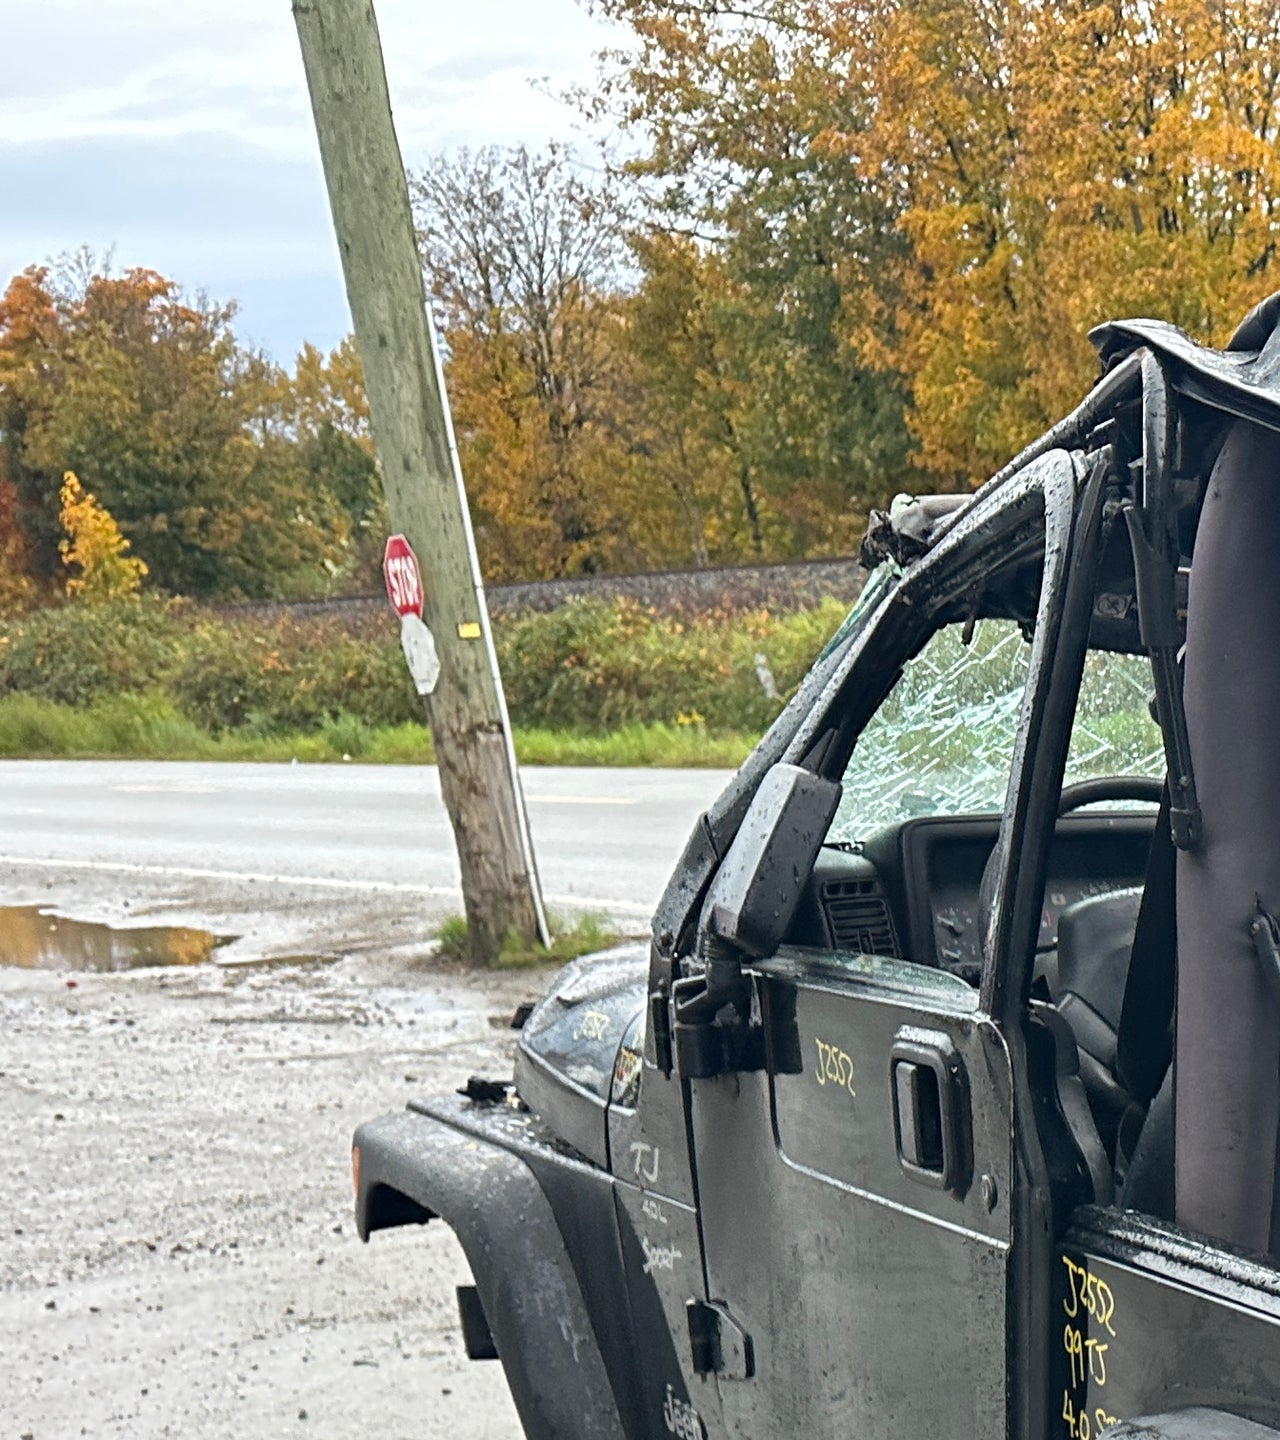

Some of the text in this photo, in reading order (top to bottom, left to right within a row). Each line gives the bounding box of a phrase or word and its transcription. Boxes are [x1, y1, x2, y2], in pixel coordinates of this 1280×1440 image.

[388, 556, 420, 608] STOP
[815, 1037, 856, 1096] J2552
[629, 1140, 660, 1184] TJ
[1062, 1255, 1116, 1338] J2552
